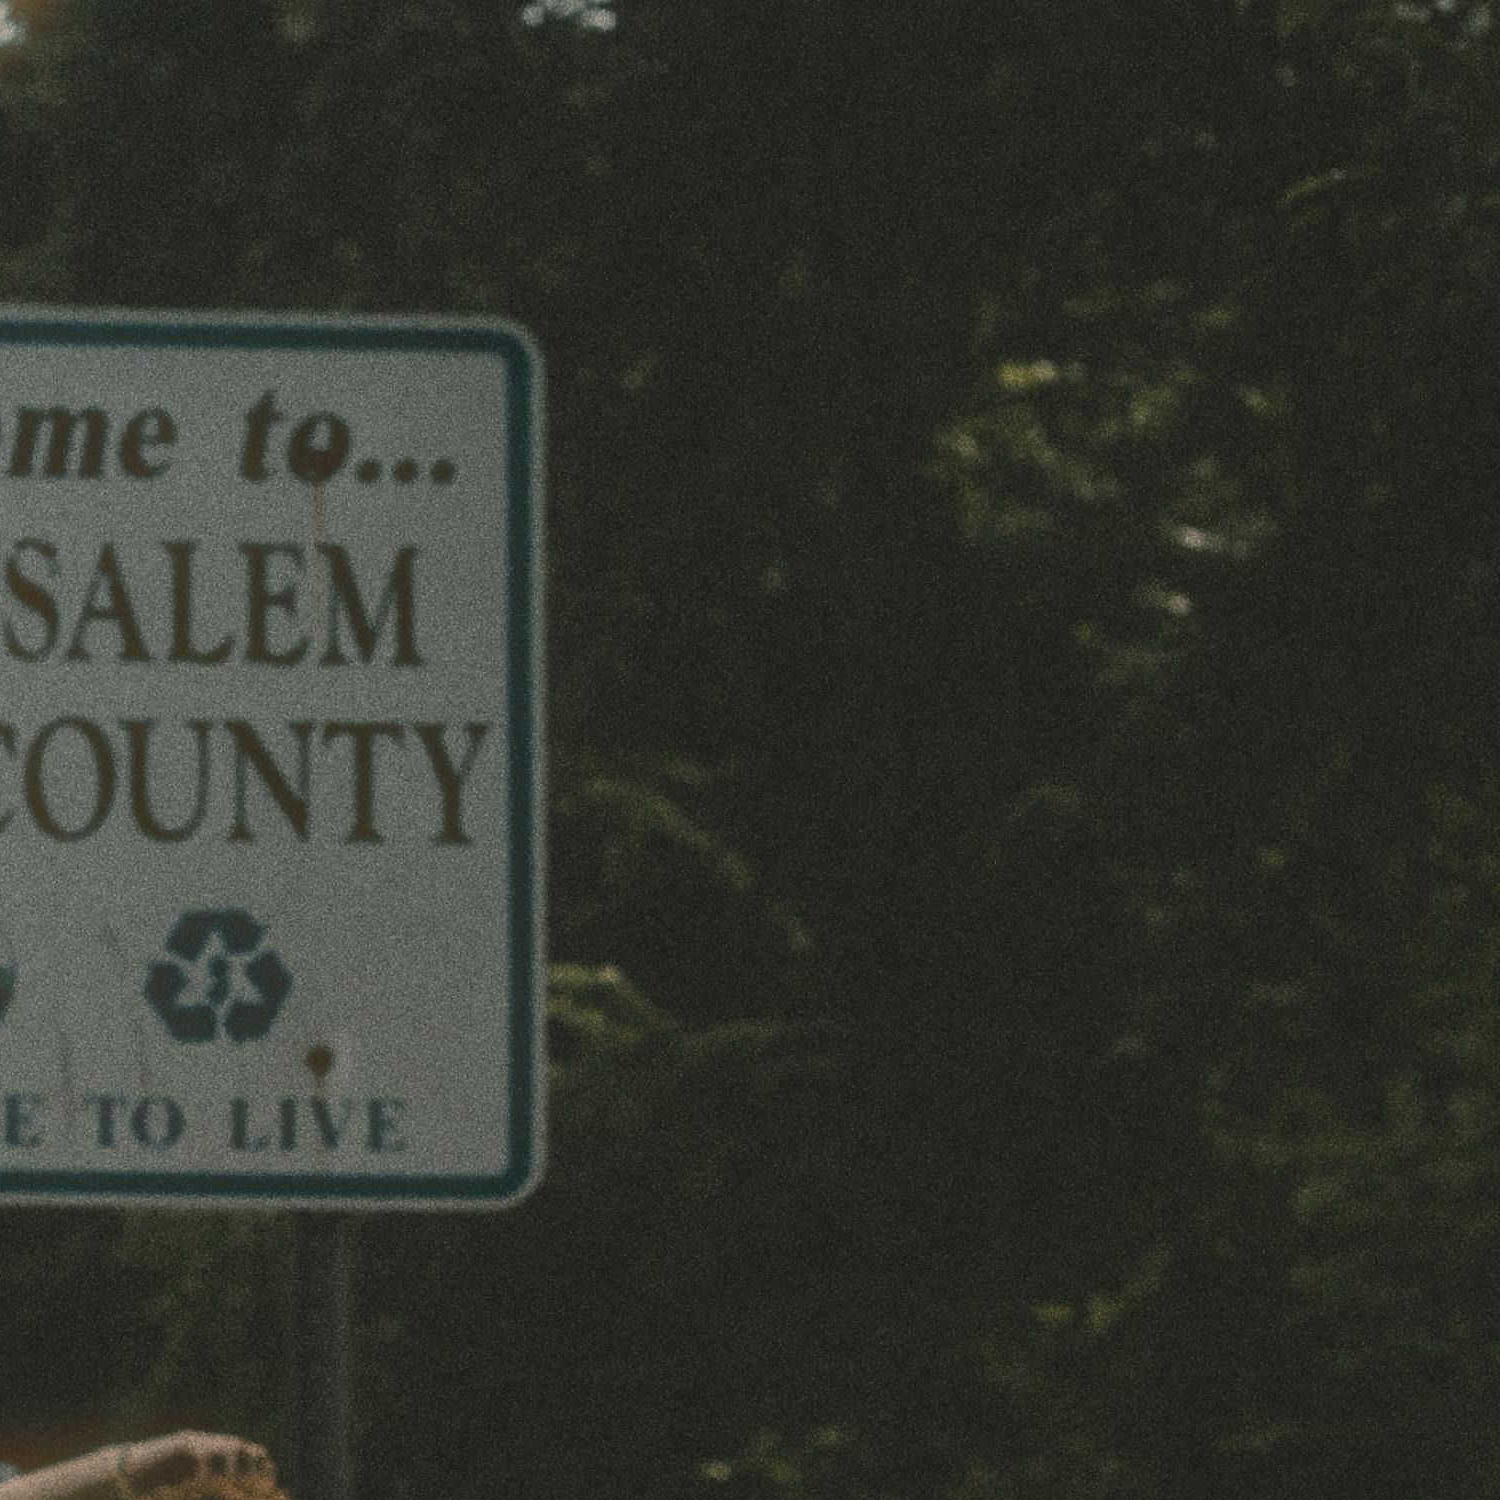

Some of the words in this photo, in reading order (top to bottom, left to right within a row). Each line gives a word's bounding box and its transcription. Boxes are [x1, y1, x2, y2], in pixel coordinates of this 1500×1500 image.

[3, 537, 426, 667] SALEM
[88, 1092, 187, 1148] TO
[228, 1095, 410, 1154] LIVE
